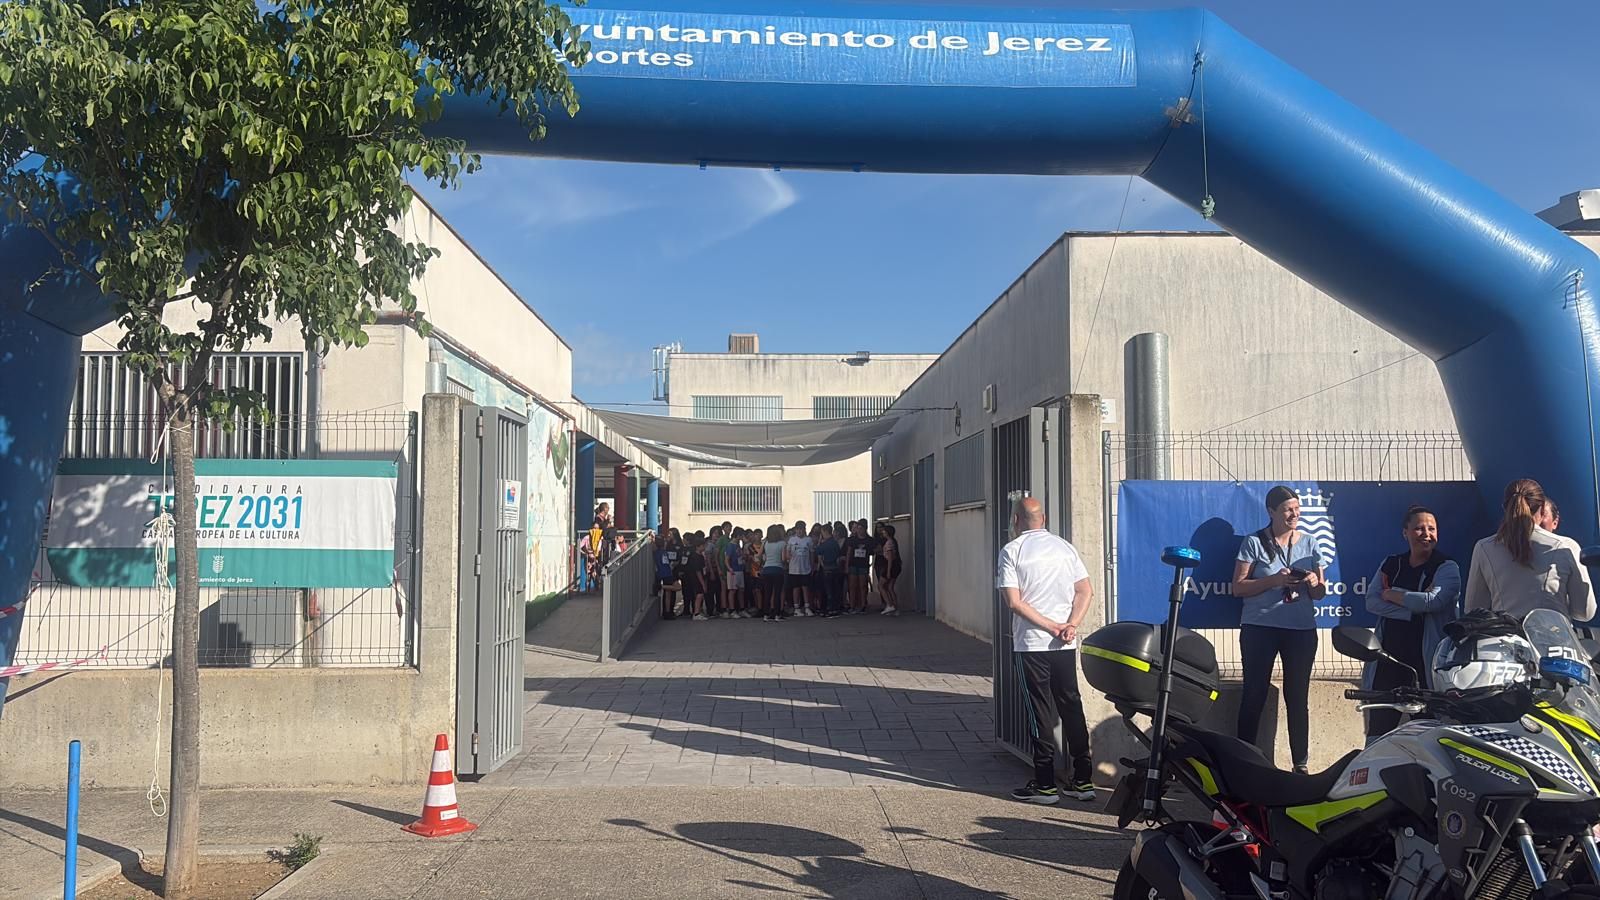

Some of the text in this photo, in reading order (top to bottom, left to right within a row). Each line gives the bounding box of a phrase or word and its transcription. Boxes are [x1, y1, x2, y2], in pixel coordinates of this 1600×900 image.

[908, 30, 969, 50] de
[983, 31, 1113, 56] Jerez
[148, 484, 303, 495] CADIDATURA
[236, 495, 303, 529] 2031
[229, 530, 241, 539] DE
[244, 530, 256, 539] LA
[259, 530, 300, 540] CULTURA
[1353, 577, 1367, 595] d
[1490, 767, 1521, 785] LOCAL
[1450, 784, 1476, 803] 092
